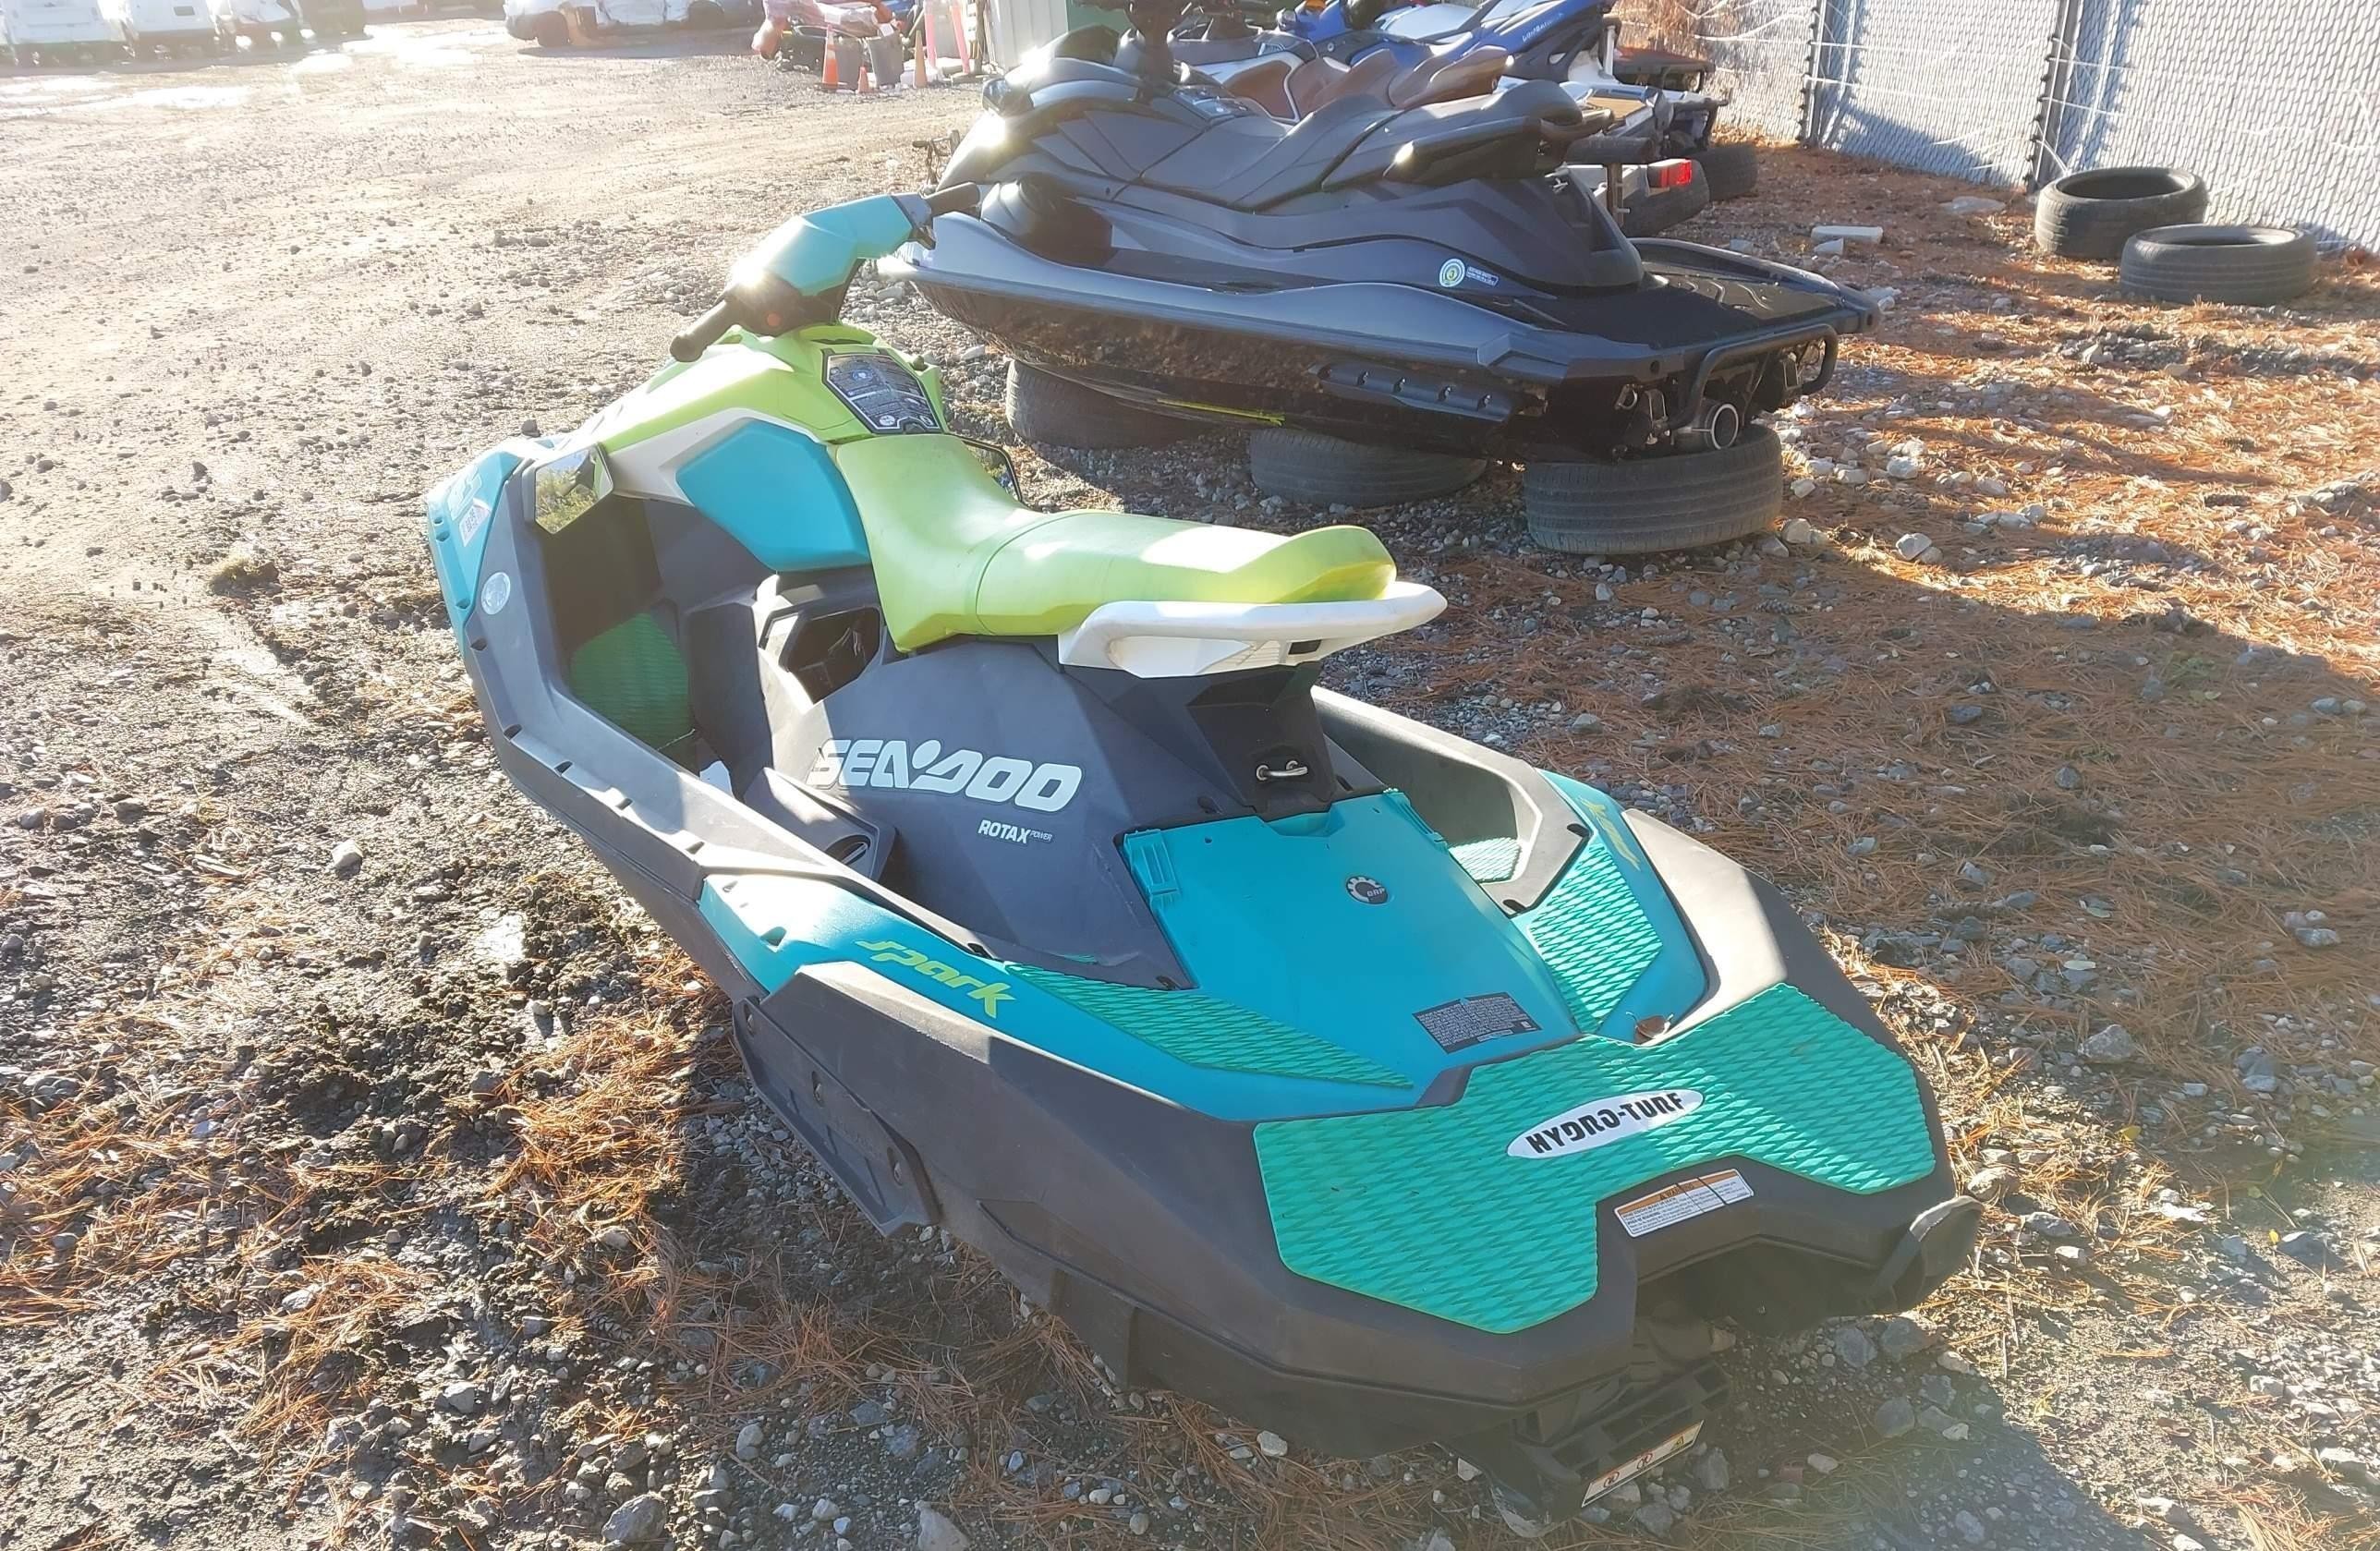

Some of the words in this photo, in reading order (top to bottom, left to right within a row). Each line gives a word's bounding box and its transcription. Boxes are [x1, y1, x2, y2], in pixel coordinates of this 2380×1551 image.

[978, 819, 1031, 844] ROTAX
[1029, 830, 1053, 842] POWER
[1524, 1092, 1685, 1154] HYDRO-TURF
